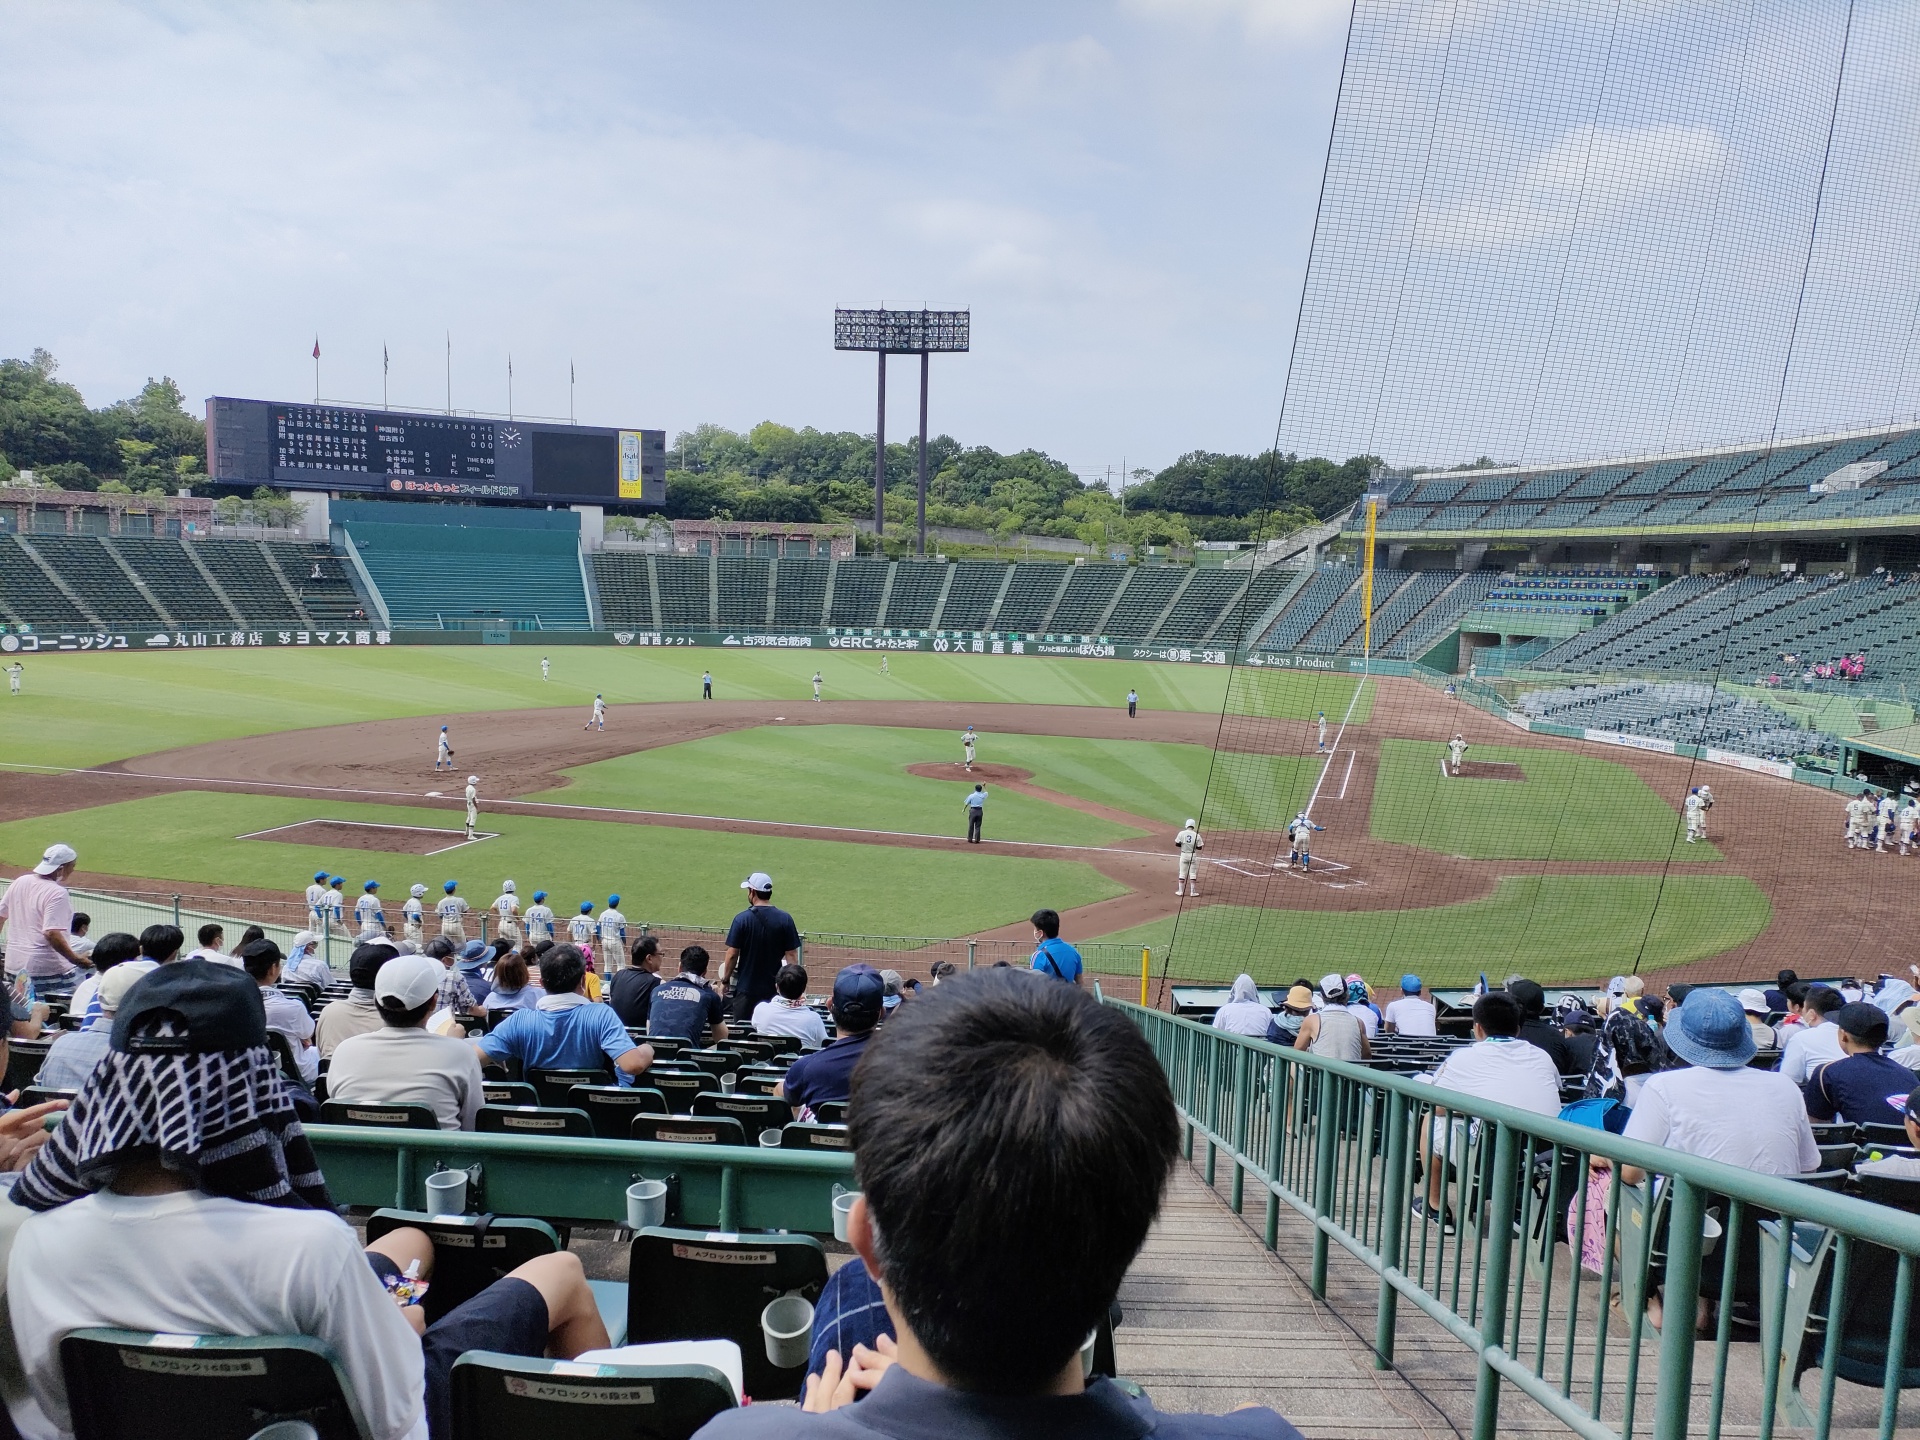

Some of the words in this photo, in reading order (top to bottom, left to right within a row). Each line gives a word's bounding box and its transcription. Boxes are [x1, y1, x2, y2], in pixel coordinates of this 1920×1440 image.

[22, 634, 128, 651] コーニッシュ
[173, 632, 264, 647] 丸山工務店
[296, 631, 391, 645] ヨマス商事
[640, 636, 695, 646] 関西タクト
[840, 637, 873, 648] ERC
[953, 639, 1025, 655] 大岡産業
[1133, 648, 1166, 659] タクシーは
[1180, 649, 1226, 664] 第一交通
[1267, 655, 1290, 667] Rays
[1295, 656, 1334, 669] Product
[1186, 835, 1192, 844] 3
[445, 905, 456, 915] 15
[500, 900, 508, 910] 13
[531, 912, 542, 923] 14
